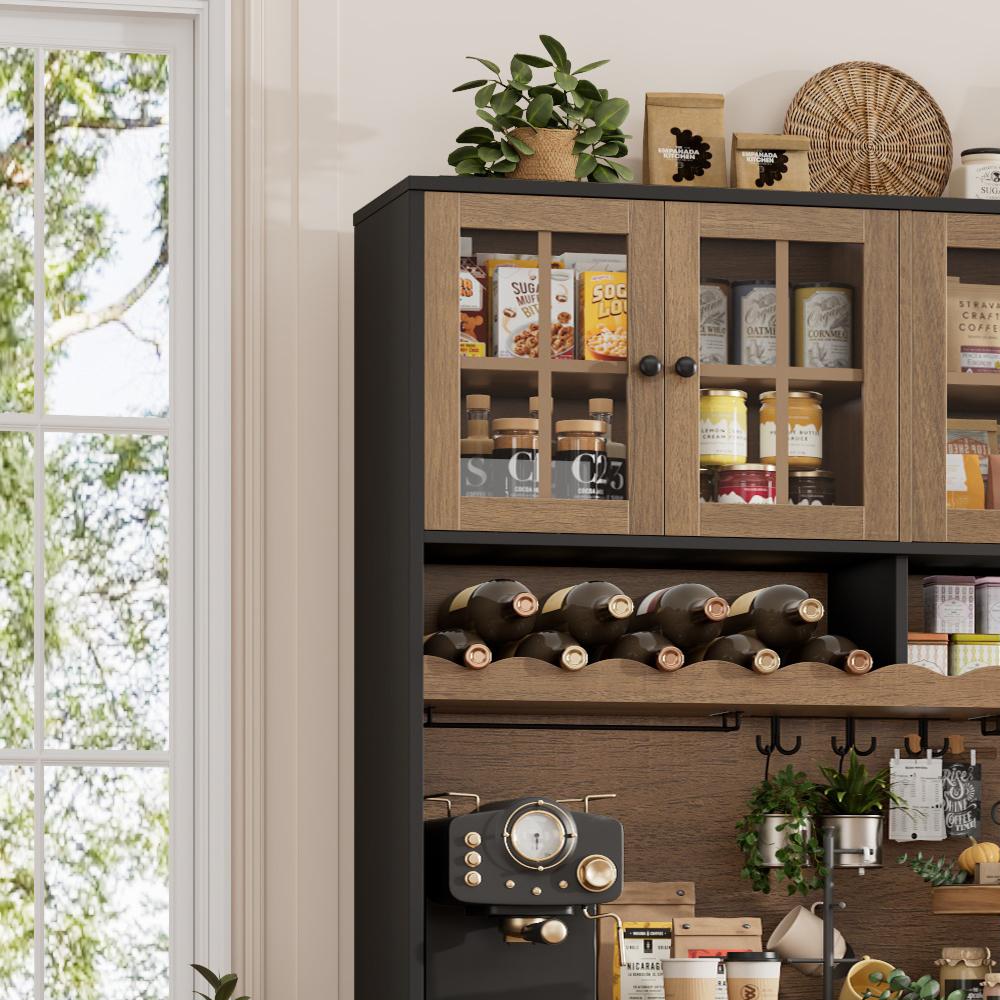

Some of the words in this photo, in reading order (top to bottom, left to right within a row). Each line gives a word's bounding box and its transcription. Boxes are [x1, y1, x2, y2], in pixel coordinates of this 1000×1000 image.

[511, 281, 540, 295] SUGA
[592, 284, 628, 303] SOG
[515, 294, 540, 306] MUF
[521, 304, 540, 319] BIT
[962, 311, 1000, 320] CRAFT
